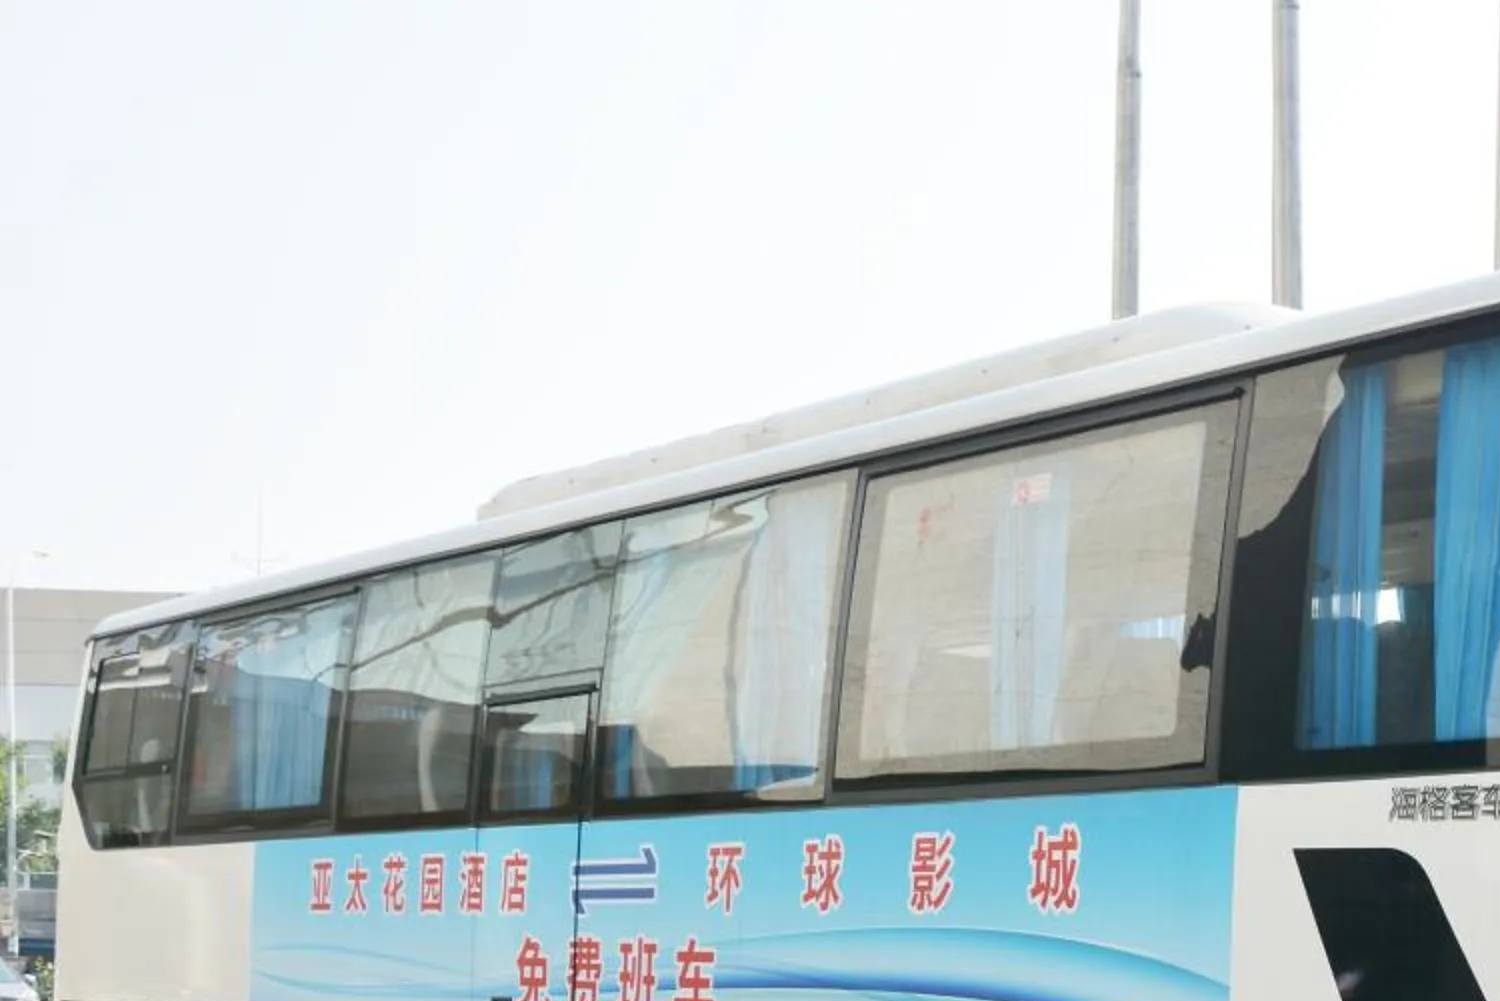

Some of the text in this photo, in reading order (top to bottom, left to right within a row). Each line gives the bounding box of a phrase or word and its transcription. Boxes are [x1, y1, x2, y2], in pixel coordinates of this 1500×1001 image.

[309, 822, 1081, 914] 亚太花园酒店 环球影城
